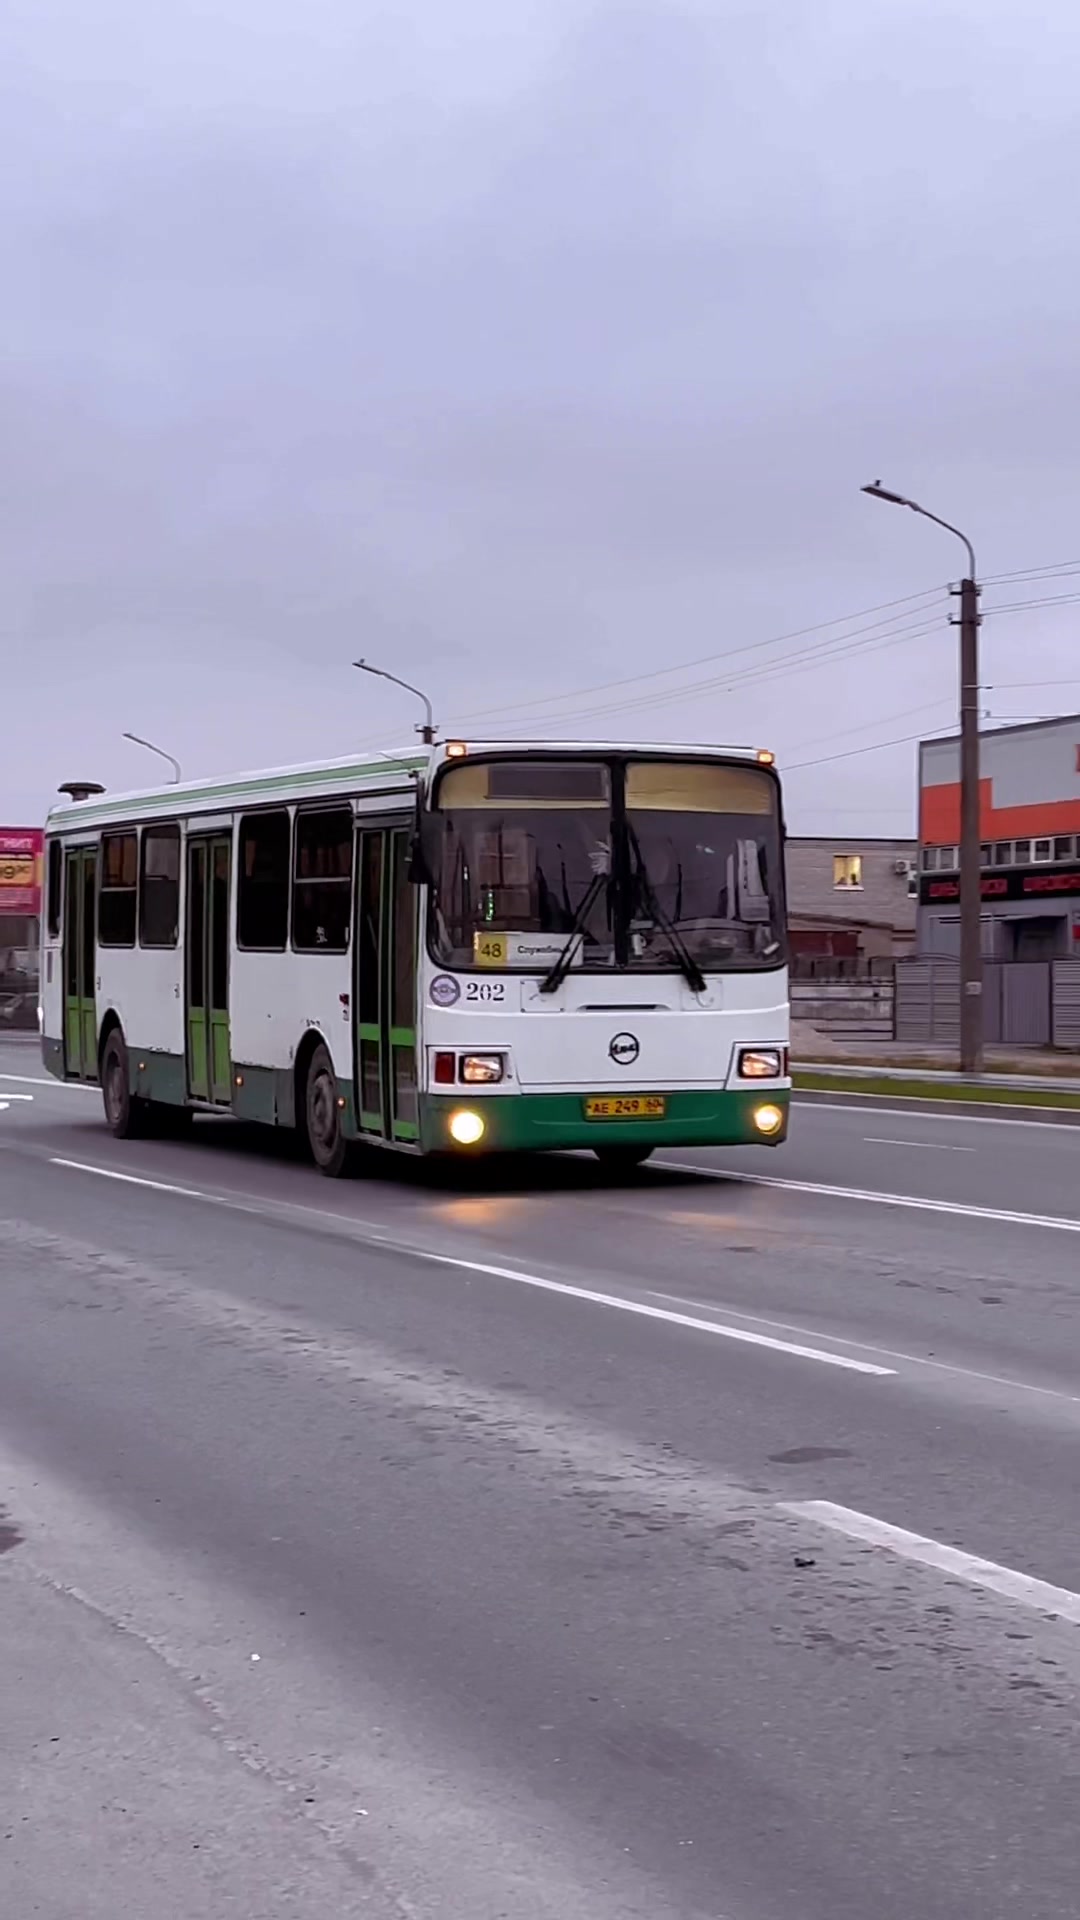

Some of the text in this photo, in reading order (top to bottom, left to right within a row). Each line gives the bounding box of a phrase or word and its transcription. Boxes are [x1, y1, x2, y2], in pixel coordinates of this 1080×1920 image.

[481, 943, 502, 958] 48
[466, 982, 505, 1001] 202
[615, 1100, 640, 1114] 249
